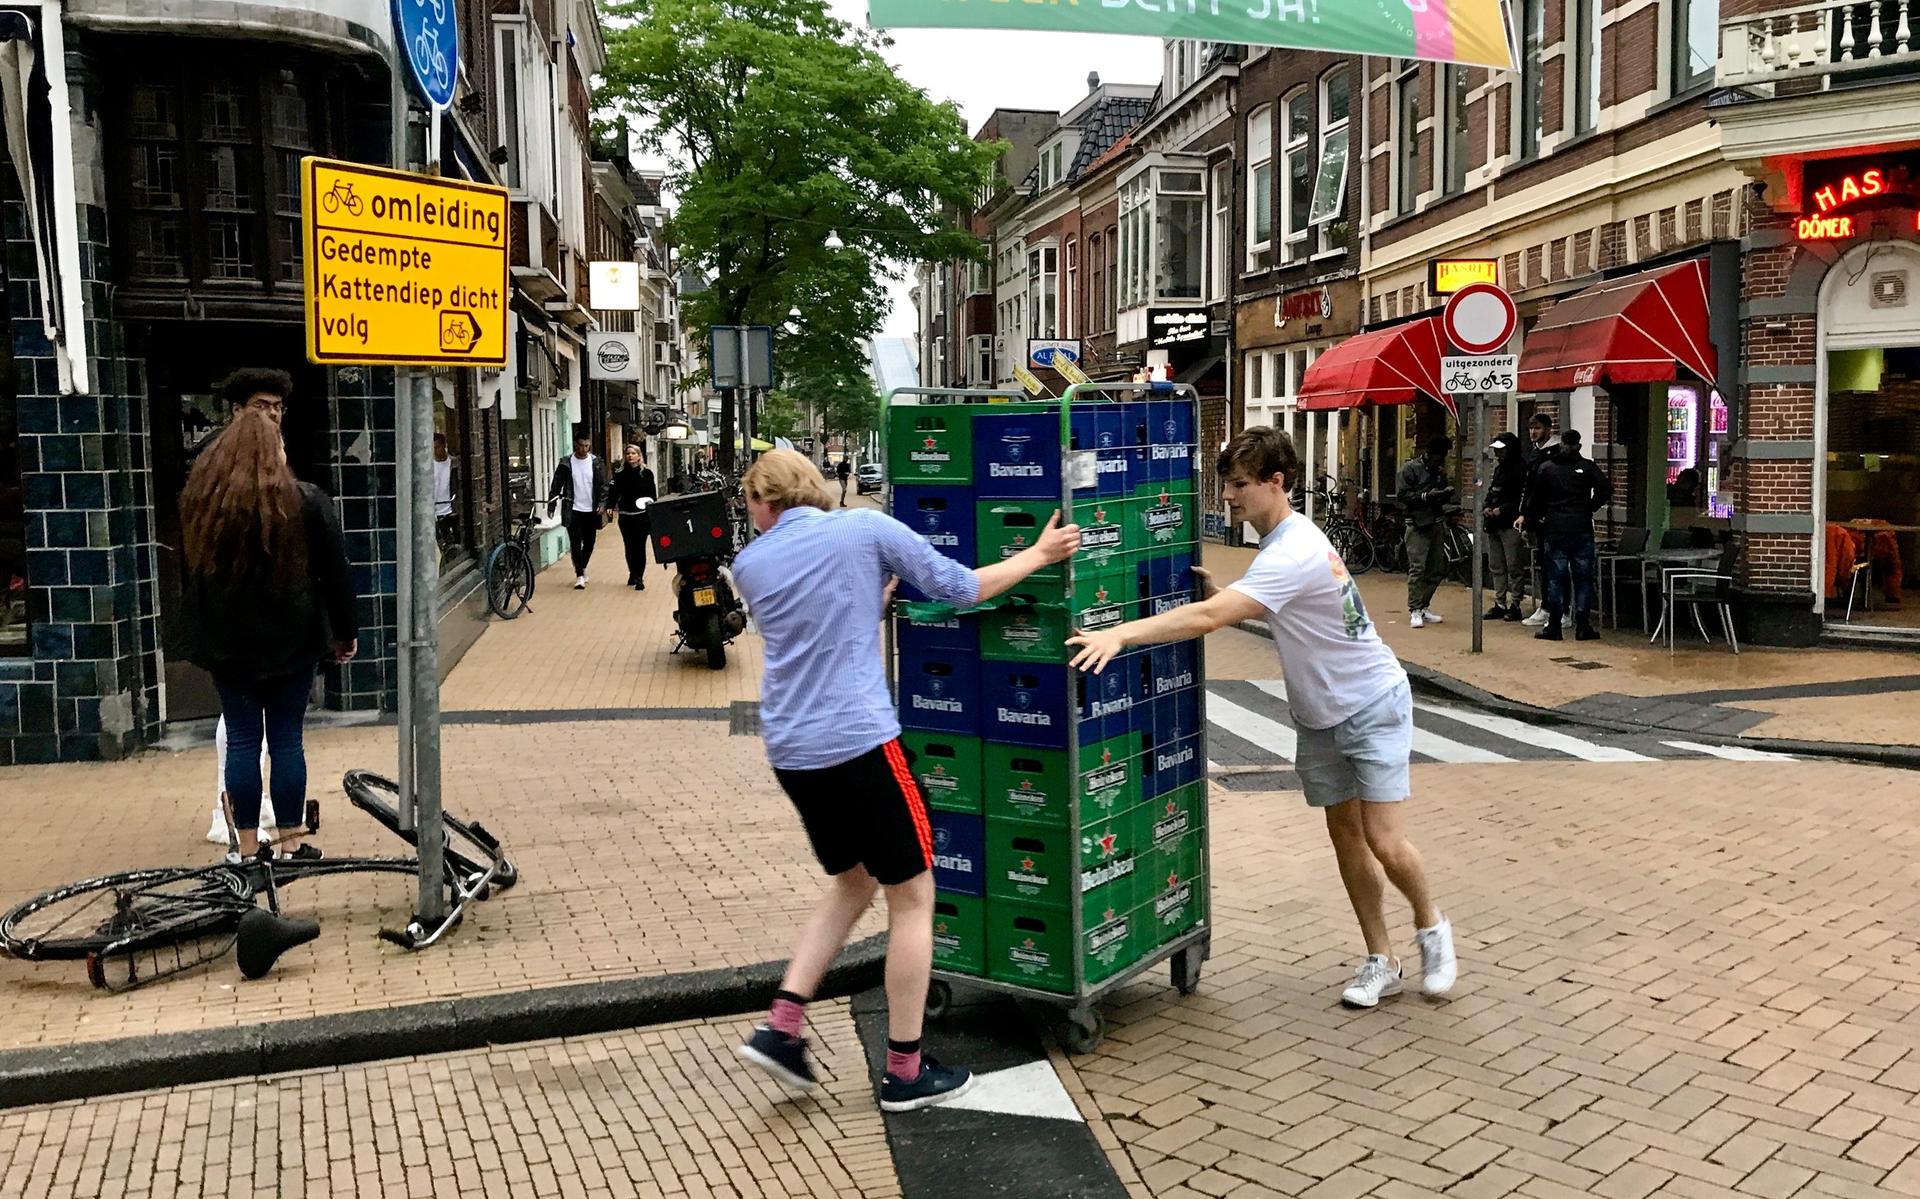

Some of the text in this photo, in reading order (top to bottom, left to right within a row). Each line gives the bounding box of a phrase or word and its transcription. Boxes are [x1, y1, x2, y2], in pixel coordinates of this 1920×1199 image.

[1814, 170, 1881, 212] HAS
[371, 193, 500, 242] omleiding
[1799, 213, 1851, 240] DÖNER
[321, 235, 432, 272] Gedempte
[1439, 263, 1494, 279] HASRET
[323, 273, 499, 310] Kattendiep dicht
[322, 313, 368, 345] volg
[1445, 357, 1513, 369] uitgezonderd
[1152, 441, 1188, 460] Bavaria
[988, 461, 1044, 477] Bavaria
[1096, 454, 1128, 474] varia
[925, 531, 959, 546] aria
[1156, 670, 1192, 694] Bavaria
[912, 694, 963, 713] Bavaria
[997, 707, 1051, 726] Bavaria
[1157, 745, 1193, 772] Bavaria
[932, 853, 973, 873] varia
